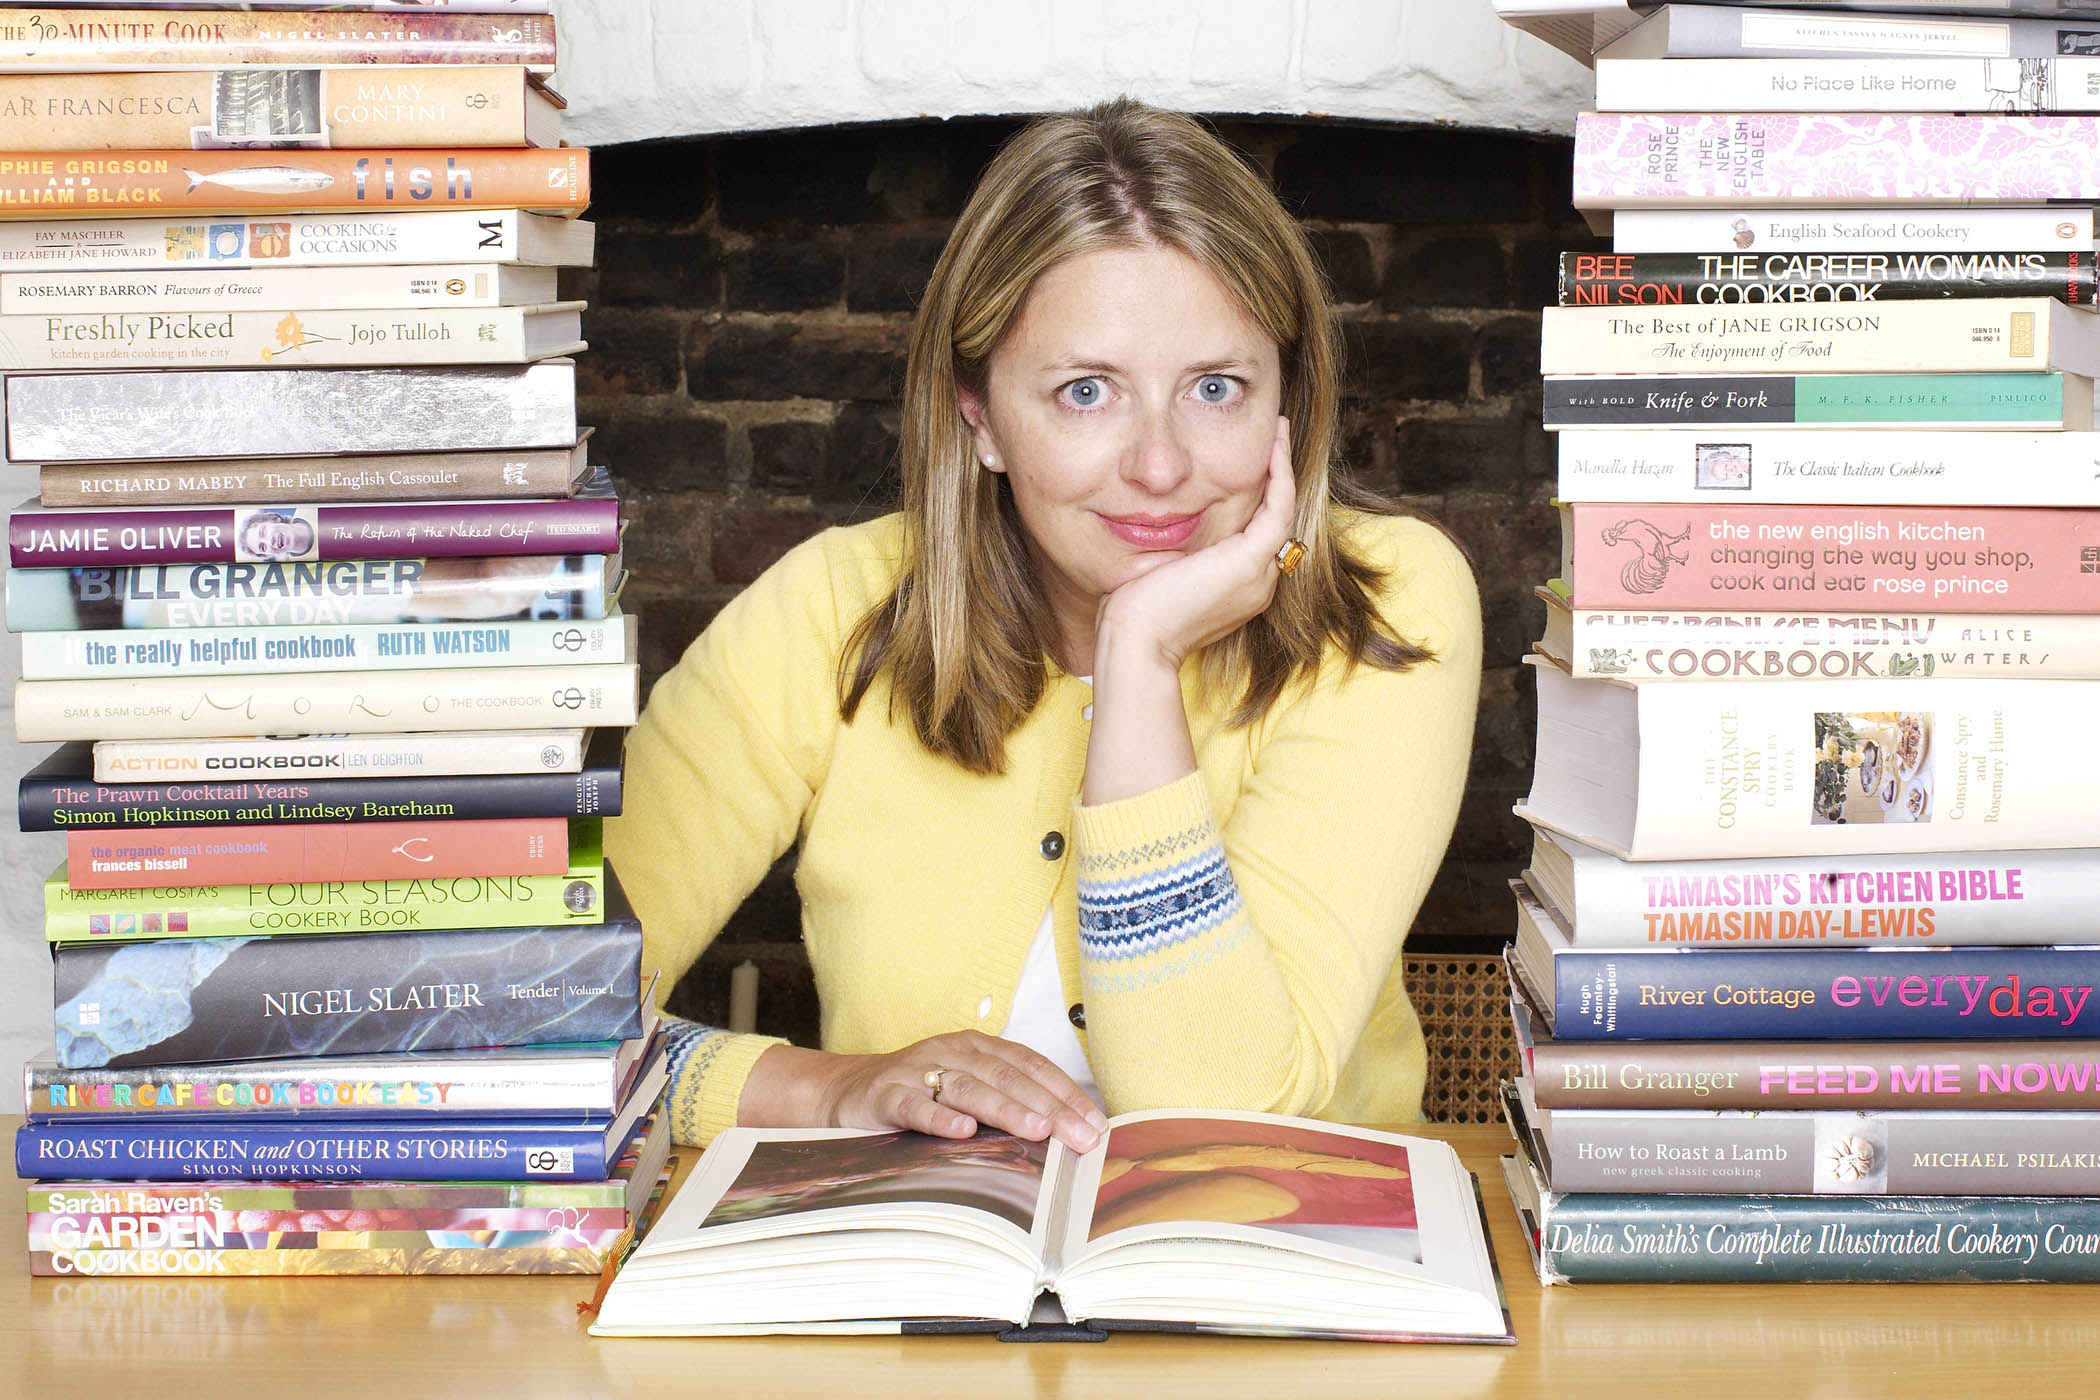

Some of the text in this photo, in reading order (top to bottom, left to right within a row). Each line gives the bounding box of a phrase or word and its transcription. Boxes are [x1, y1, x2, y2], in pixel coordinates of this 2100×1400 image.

[164, 20, 227, 44] COOK
[357, 84, 426, 102] MARY
[1772, 75, 1957, 92] No Place Like Home
[48, 97, 201, 116] FRANCESCA
[333, 104, 447, 124] CONTINI
[1647, 133, 1663, 175] ROSE
[1665, 126, 1680, 183] PRINCE
[1699, 138, 1713, 169] THE
[1716, 136, 1731, 172] NEW
[1733, 122, 1749, 188] ENGLISH
[1751, 130, 1766, 179] TABLE
[66, 160, 169, 175] GRIGSON
[352, 157, 472, 201] fish
[87, 188, 163, 203] BLACK
[34, 230, 126, 242] FAY MASCHLER
[300, 223, 384, 238] COOKING
[1768, 223, 1971, 243] English Seafood Cookery
[2, 247, 157, 261] ELIZABETH JANE HOWARD
[300, 239, 398, 253] OCCASIONS
[1575, 254, 2047, 281] BEE THE CAREER WOMAN'S
[99, 283, 264, 297] BARRON Flavours of Greece
[46, 313, 235, 345] Freshly Picked
[348, 323, 451, 345] Jojo Tulloh
[1608, 316, 1881, 338] The Best of JANE GRIGSON
[50, 348, 231, 360] kitchen garden cooking in the city
[80, 469, 459, 493] RICHARD MABEY The Full English Cassoulet
[1773, 461, 1946, 477] The Classic Italian Cookbook
[22, 520, 535, 553] JAMIE OLIVER The Return Naked Chef
[1709, 520, 1986, 545] the new english kitchen
[80, 559, 424, 601] BILL GRANGER
[167, 599, 285, 628] EVERY
[86, 629, 511, 667] the really helpful cookbook RUTH WATSON
[1646, 649, 1879, 678] COOKBOOK
[109, 753, 424, 771] ACTION COOKBOOK LEN DEIGHTON
[1717, 708, 1740, 831] CONSTANCE
[1742, 746, 1761, 793] SPRY
[1949, 713, 1973, 821] Constance Spry
[1971, 755, 1987, 781] and
[1983, 710, 2009, 824] Rosemary Hume
[52, 783, 310, 804] The Prawn Cocktail Years
[115, 841, 268, 859] organic meat cookbook
[92, 857, 188, 872] frances bissell
[1642, 869, 2024, 908] TAMASIN'S KITCHEN BIBLE
[249, 909, 422, 929] COOKERY BOOK
[1643, 907, 1936, 943] TAMASIN DAY-LEWIS
[263, 982, 608, 1017] NIGEL SLATER Tender Volume
[1580, 983, 1590, 1015] Hugh
[1593, 972, 1604, 1026] Fearnley-
[1606, 963, 1619, 1033] Whittingstall
[1639, 974, 2093, 1027] River Cottage everyday
[1561, 1064, 1961, 1097] Bill Granger FEED ME
[49, 1082, 452, 1107] RIVER CAFE COOK BOOK EASY
[39, 1138, 508, 1160] ROAST CHICKEN and OTHER STORIES
[1577, 1143, 2009, 1168] How to Roast Lamb MICHAEL
[182, 1164, 243, 1175] SIMON
[1603, 1166, 1762, 1178] new greek classic cooking
[48, 1191, 223, 1214] Sarah Raven's
[50, 1215, 226, 1249] GARDEN
[1550, 1223, 2038, 1265] Delia Smith's Complete Illustrated Cookery
[51, 1249, 228, 1274] COOKBOOK
